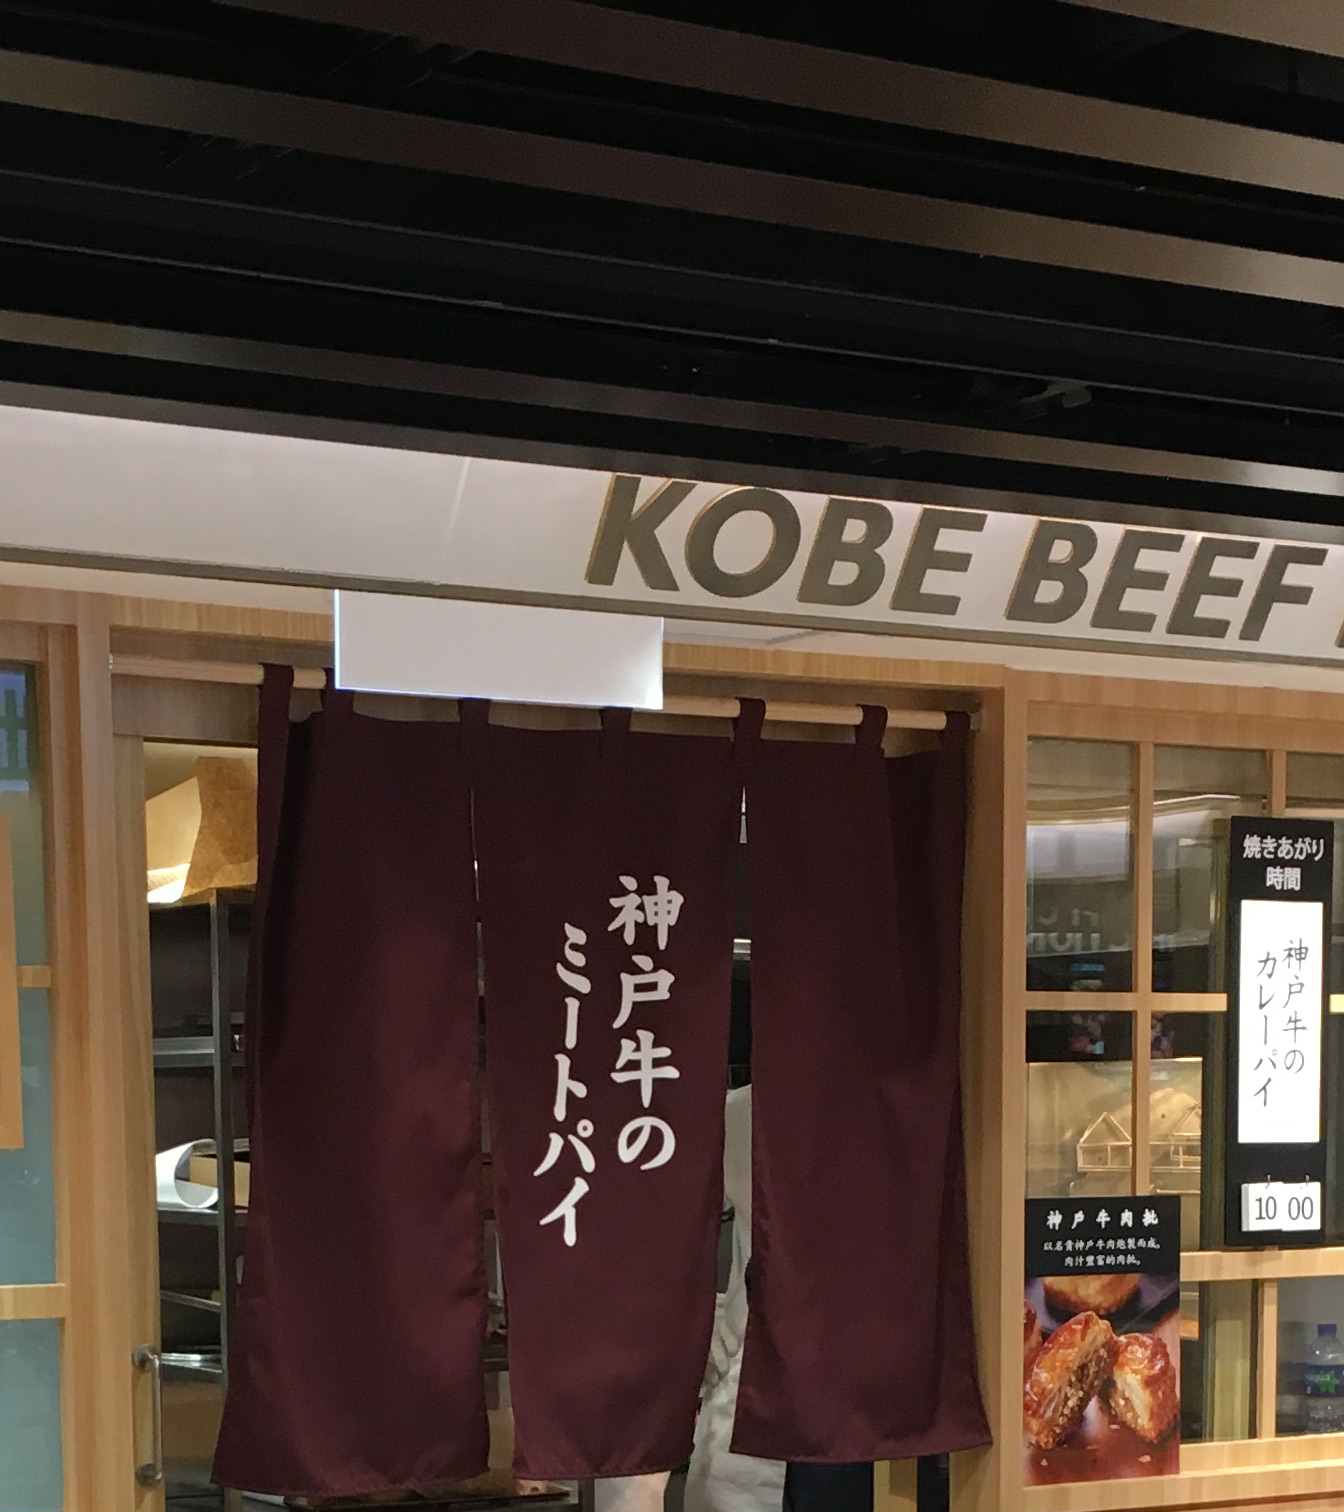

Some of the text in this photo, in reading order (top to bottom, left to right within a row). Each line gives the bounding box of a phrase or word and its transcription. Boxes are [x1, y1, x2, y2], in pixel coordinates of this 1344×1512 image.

[584, 472, 988, 615] KOBE
[1003, 516, 1329, 643] BEEF
[1243, 834, 1324, 861] 焼きあがり
[1266, 867, 1301, 891] 時間
[607, 875, 684, 1171] 神戸牛の
[1252, 951, 1280, 1108] カレーパイ
[1281, 938, 1309, 1074] 神戸牛の
[533, 922, 596, 1247] ミートパイ
[1255, 1196, 1314, 1220] 10 00
